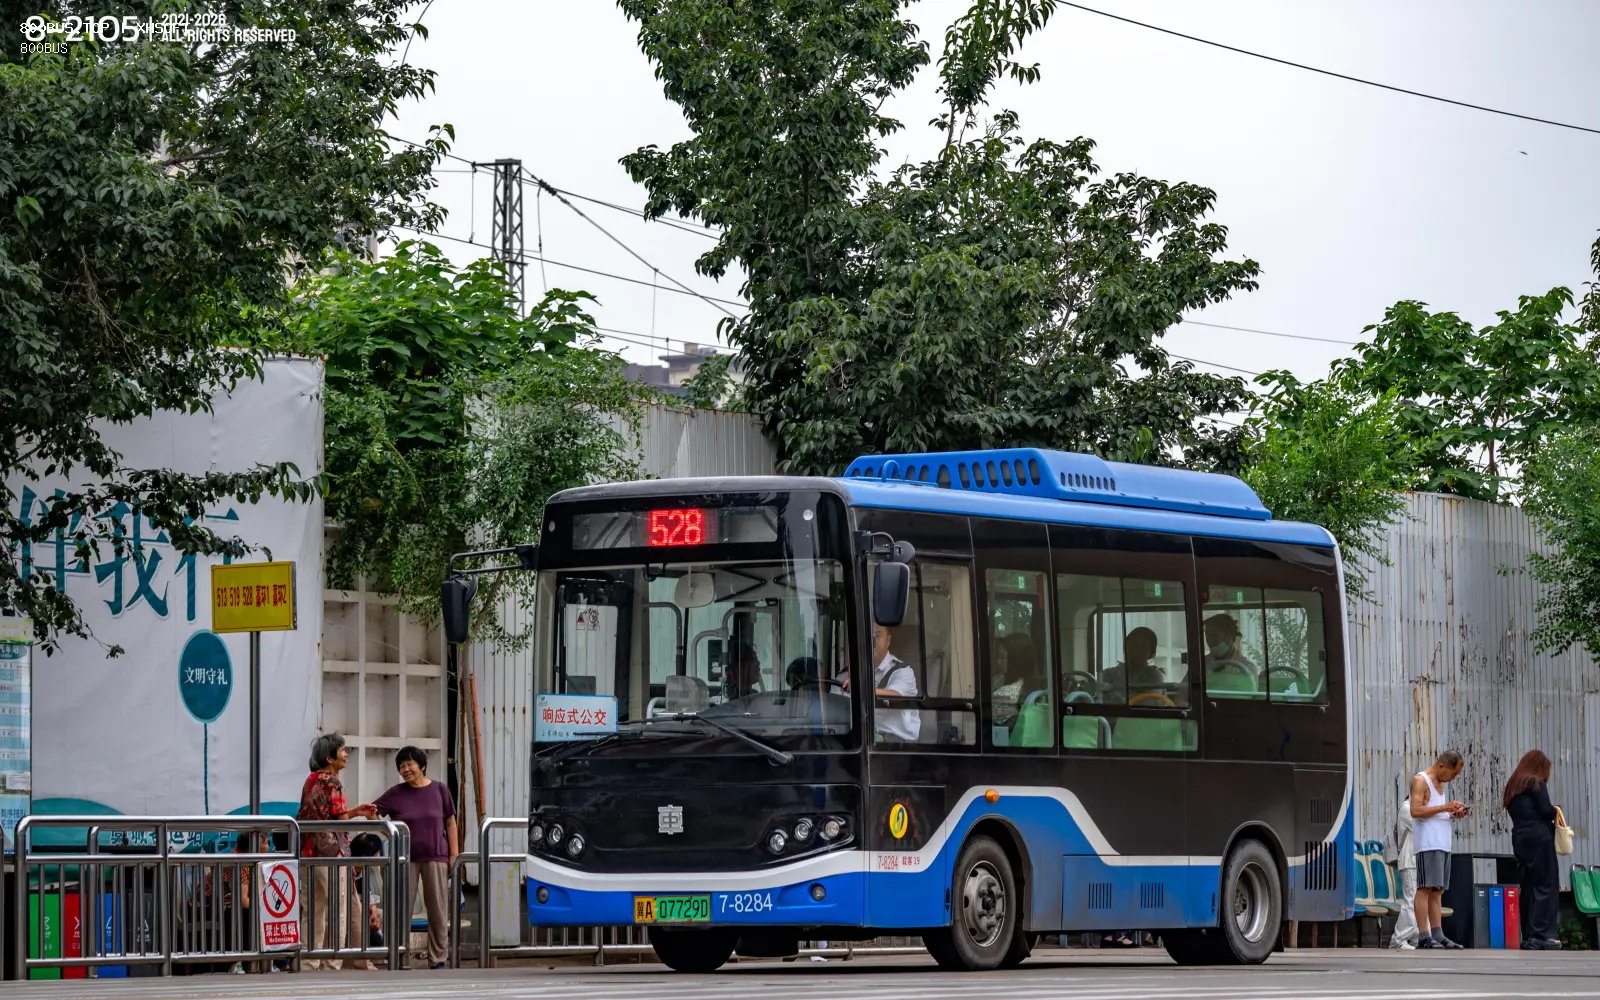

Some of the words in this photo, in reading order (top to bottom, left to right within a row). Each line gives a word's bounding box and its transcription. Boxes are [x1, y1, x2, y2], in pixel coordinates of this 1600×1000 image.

[651, 508, 702, 546] 528
[183, 666, 228, 685] 文明守礼
[542, 707, 607, 727] 响应式公交
[878, 855, 898, 870] 7-8284
[718, 892, 774, 913] 7-8284
[265, 922, 297, 937] 禁止吸烟
